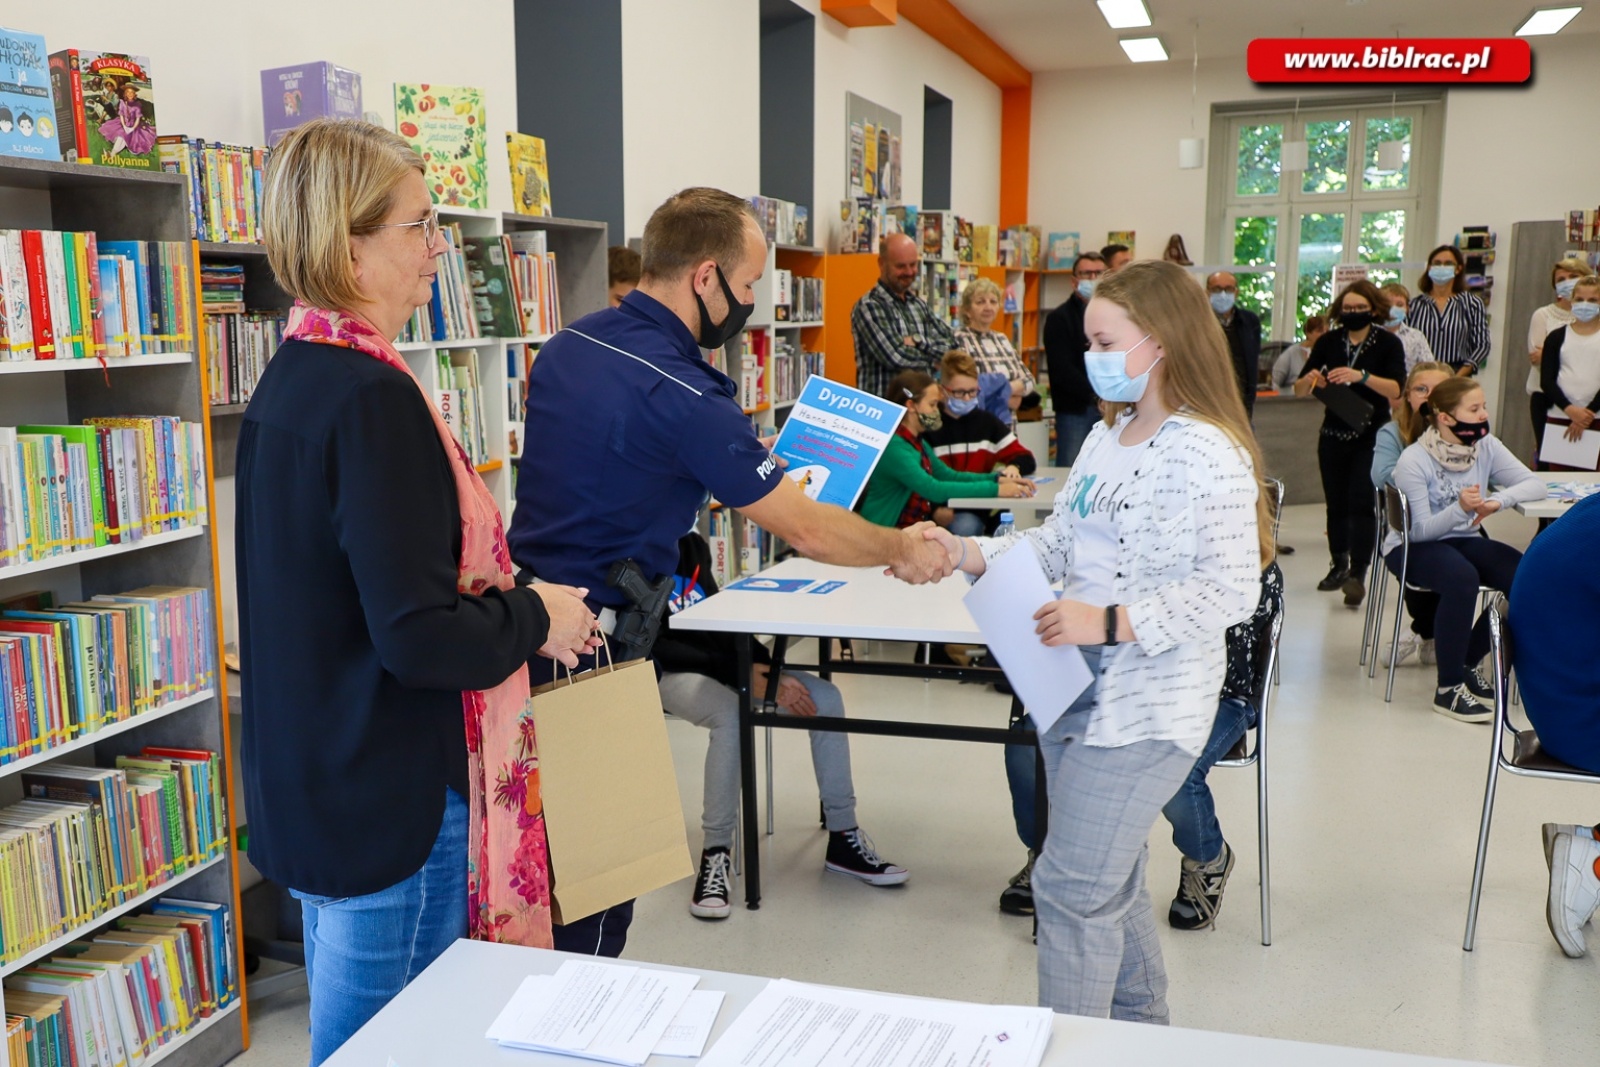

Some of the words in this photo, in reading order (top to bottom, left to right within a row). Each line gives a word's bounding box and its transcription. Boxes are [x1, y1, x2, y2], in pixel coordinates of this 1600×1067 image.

[0, 38, 37, 52] UDOWNY
[0, 51, 44, 70] HŁOPAK
[97, 59, 136, 71] KLASYKA
[101, 154, 150, 168] Pollyanna
[818, 387, 883, 420] Dyplom
[798, 407, 827, 424] Hanna
[756, 451, 777, 481] POLI
[92, 467, 101, 497] Bratki
[716, 540, 725, 574] SPORT
